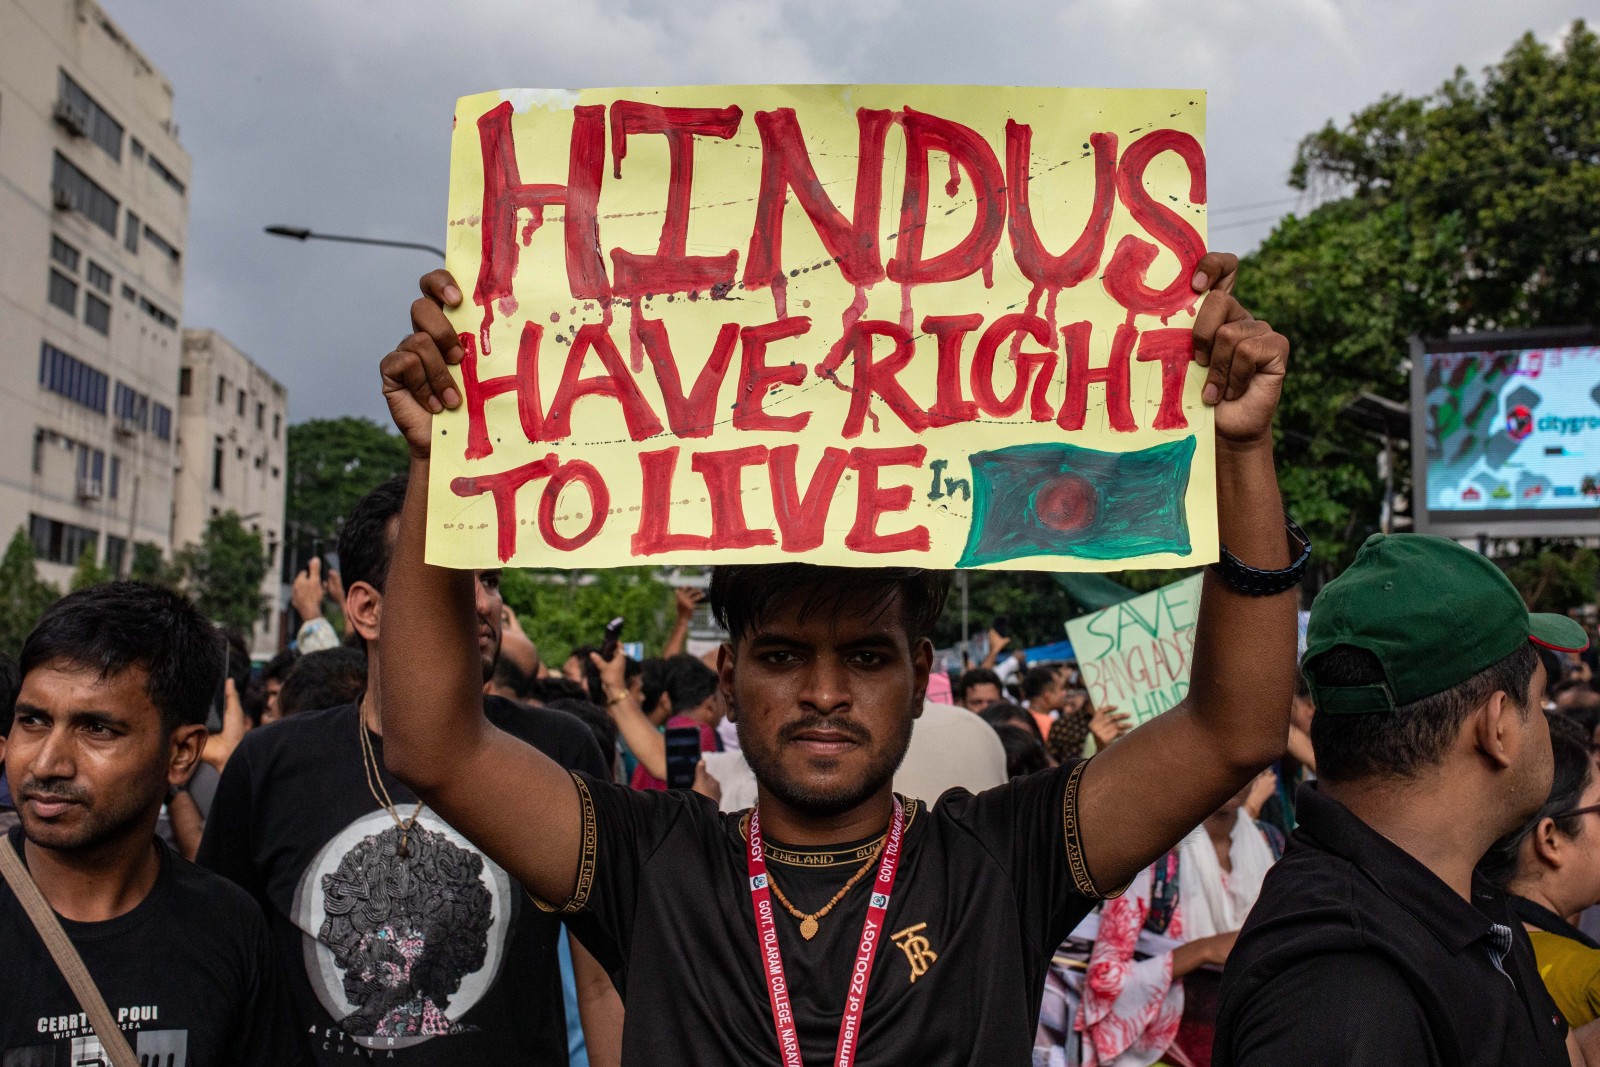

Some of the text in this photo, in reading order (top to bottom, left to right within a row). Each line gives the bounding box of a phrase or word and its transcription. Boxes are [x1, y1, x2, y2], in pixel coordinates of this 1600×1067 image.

[473, 99, 1208, 315] HINDUS
[459, 312, 1196, 460] HAVE RIGHT
[450, 444, 971, 563] TO LIVE In
[1087, 581, 1195, 661] SAVE
[772, 849, 834, 865] ENGLAND
[880, 858, 895, 882] GOVT.
[578, 860, 593, 903] ENGLA
[758, 900, 773, 928] GOVT.
[763, 927, 782, 975] TOLARAM
[851, 919, 878, 995] ZOOLOGY
[37, 1012, 90, 1033] CERRT
[771, 976, 791, 1028] COLLEGE,
[850, 995, 860, 1012] of
[322, 1041, 395, 1059] CHAYA
